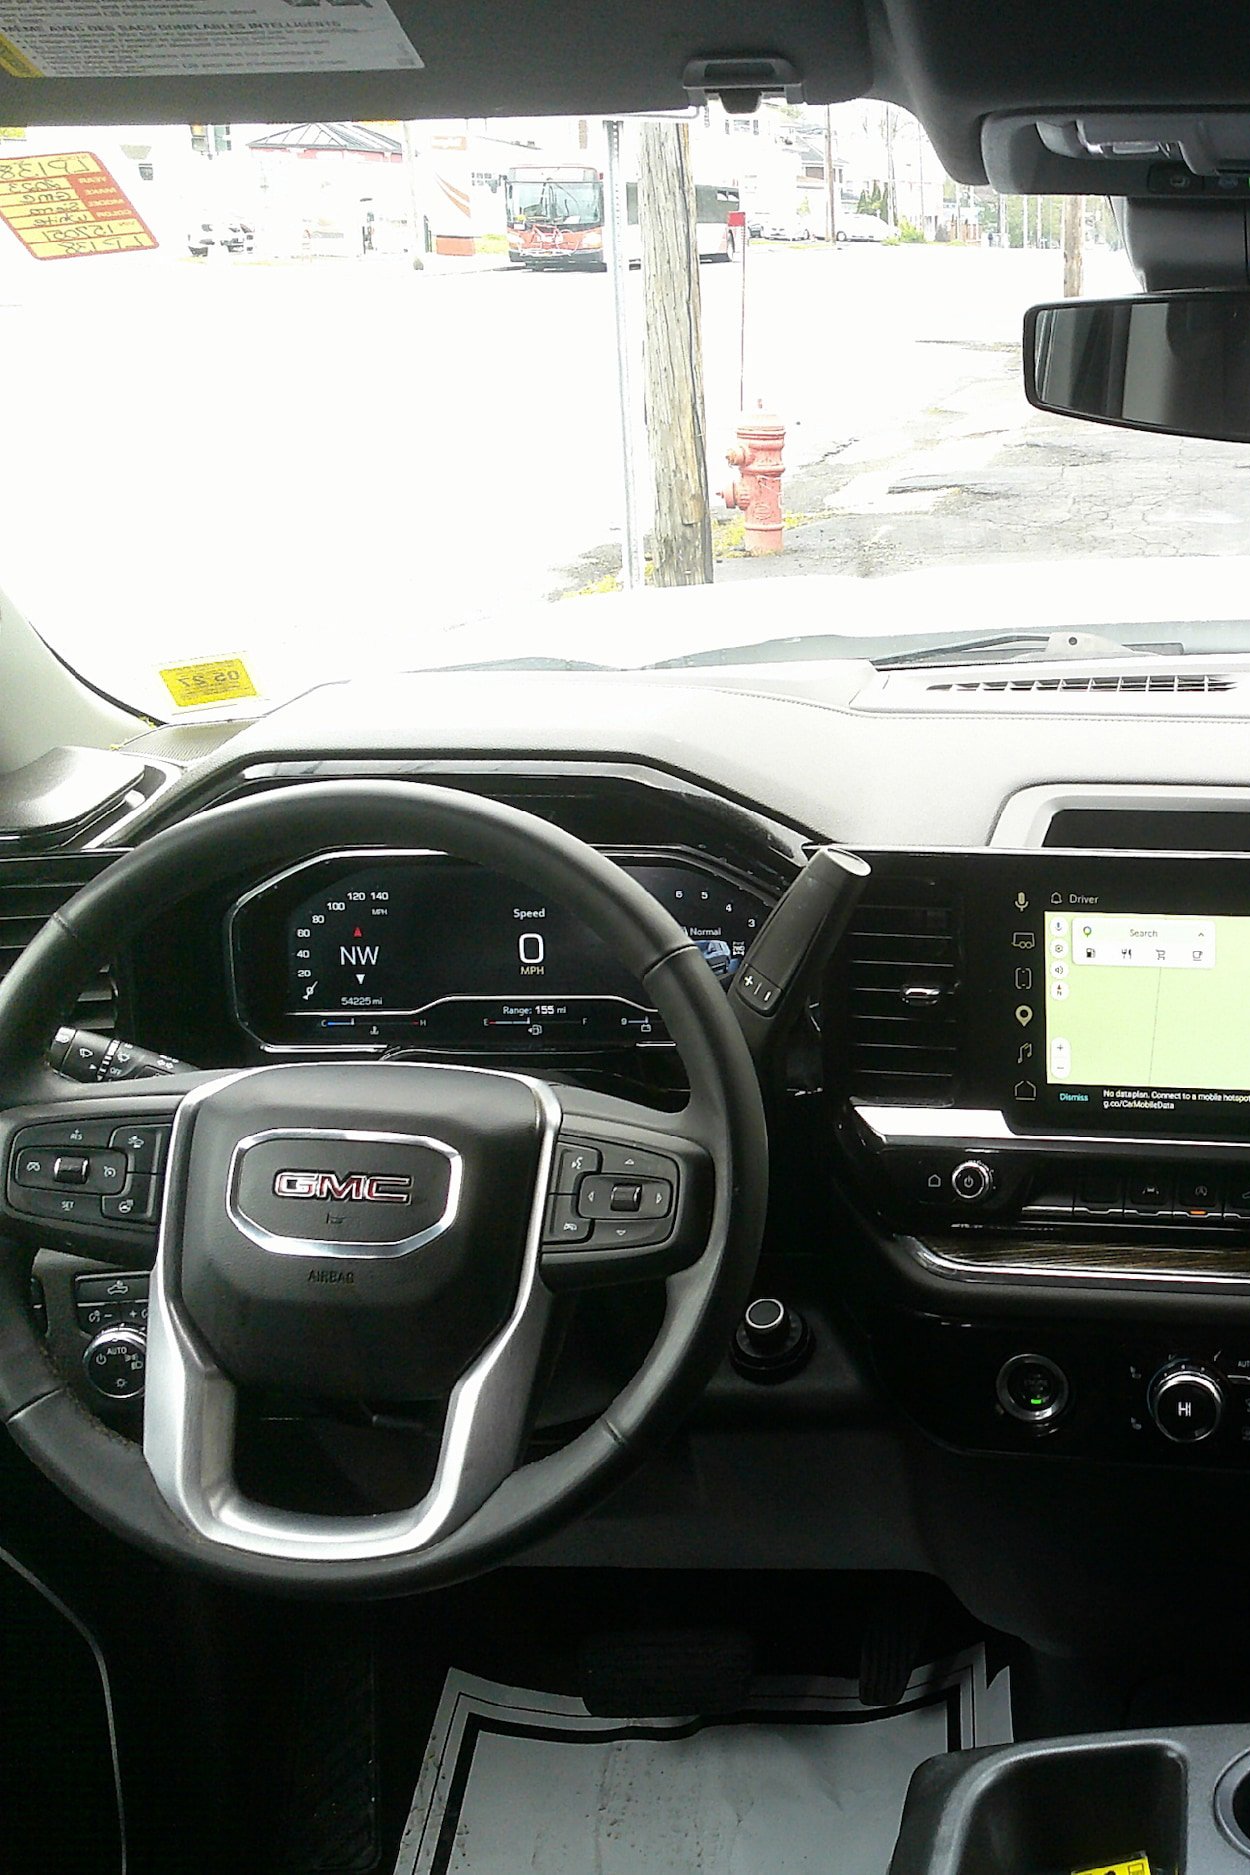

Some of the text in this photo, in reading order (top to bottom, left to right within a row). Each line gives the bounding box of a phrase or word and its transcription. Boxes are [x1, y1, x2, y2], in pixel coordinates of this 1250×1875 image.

[346, 892, 366, 901] 120
[370, 892, 389, 901] 140
[701, 891, 709, 900] 5
[1069, 894, 1099, 904] Driver
[326, 902, 346, 911] 100
[725, 903, 732, 912] 4
[372, 908, 388, 916] MPH
[513, 908, 546, 920] Speed
[312, 915, 325, 924] 80
[748, 919, 756, 928] 3
[296, 929, 311, 938] 60
[689, 927, 721, 936] Normal
[1129, 928, 1158, 938] Search
[518, 933, 544, 964] 0
[296, 950, 310, 959] 40
[339, 946, 380, 965] NW
[297, 969, 311, 978] 20
[520, 966, 545, 975] MPH
[341, 997, 383, 1005] 54225 mi
[502, 1006, 567, 1017] Range: 155 mi
[483, 1018, 489, 1026] E
[582, 1018, 588, 1026] F
[1059, 1092, 1089, 1102] Dismiss
[1103, 1089, 1115, 1098] No
[1151, 1090, 1181, 1100] Connect
[1182, 1092, 1191, 1100] to
[1198, 1093, 1222, 1101] mobile
[274, 1171, 414, 1204] GMC
[307, 1270, 354, 1283] AIRBAG
[106, 1346, 128, 1355] AUTO
[1178, 1402, 1192, 1417] HI
